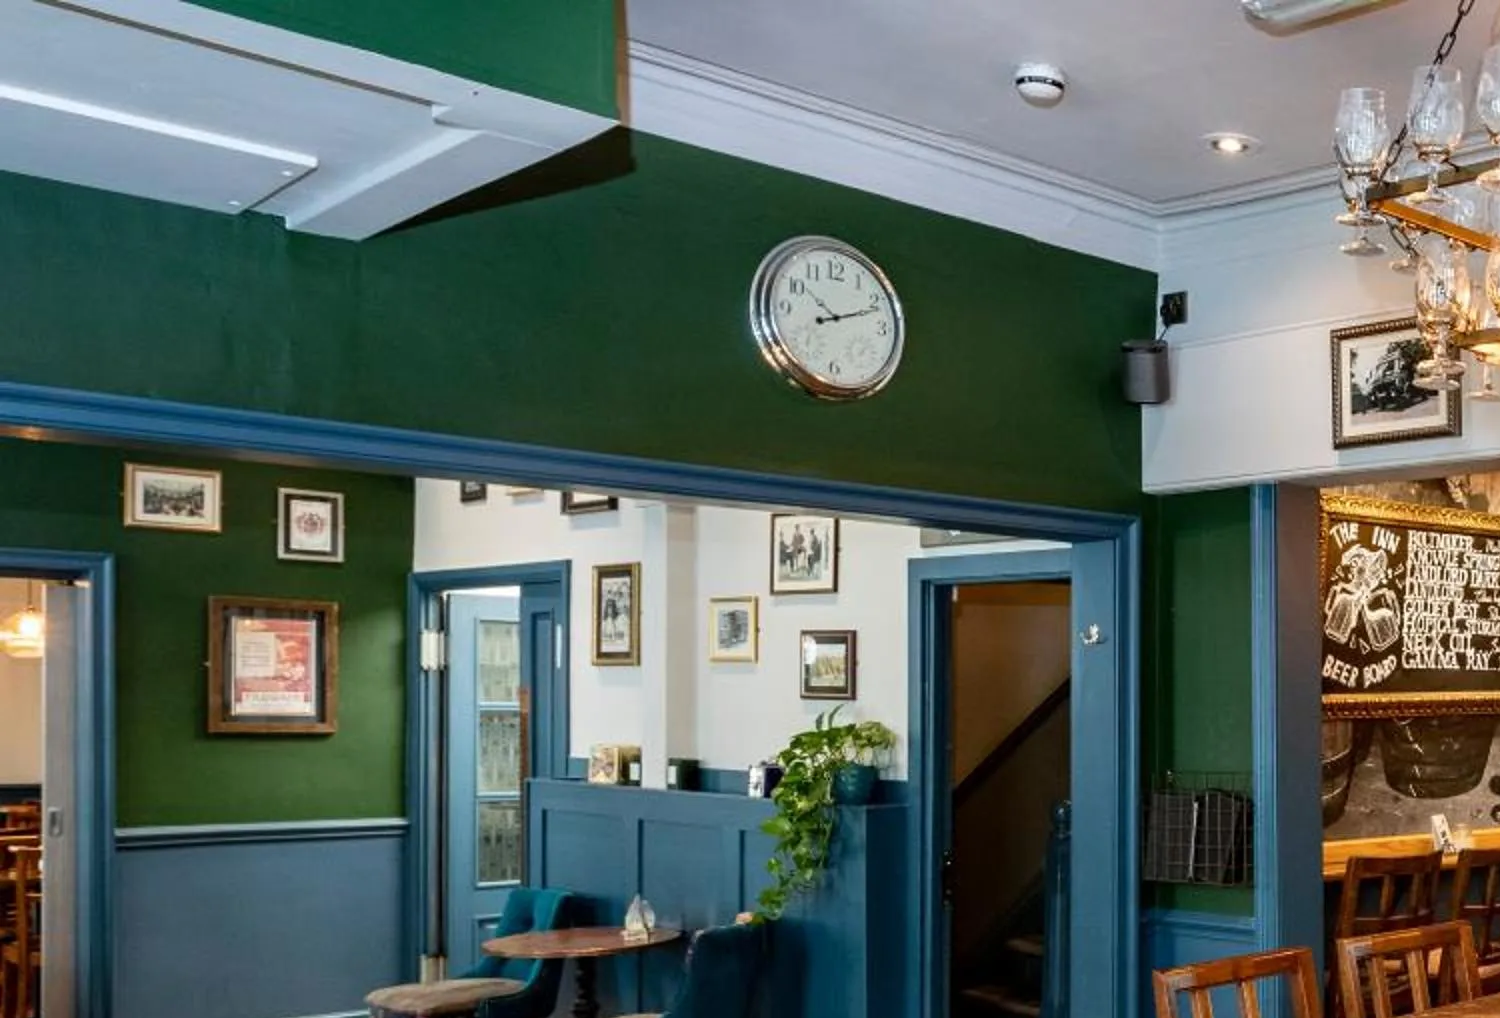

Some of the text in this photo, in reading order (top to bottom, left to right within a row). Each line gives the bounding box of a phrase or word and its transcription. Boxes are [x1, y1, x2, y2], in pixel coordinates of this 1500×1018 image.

[807, 262, 820, 282] 11
[826, 259, 845, 283] 12
[855, 273, 861, 290] 1
[789, 275, 805, 296] 10
[779, 299, 792, 315] 9
[869, 293, 879, 311] 2
[876, 319, 887, 336] 3
[1329, 521, 1401, 555] THE INN
[1407, 544, 1459, 567] KNOWLE
[1405, 560, 1468, 586] LANDLORD
[1403, 598, 1449, 618] GOLDEN
[1454, 601, 1479, 619] BEST
[1402, 632, 1445, 653] NECK
[1449, 631, 1472, 653] OIL
[1465, 649, 1493, 670] RAY
[1321, 653, 1398, 689] BEER BOARD
